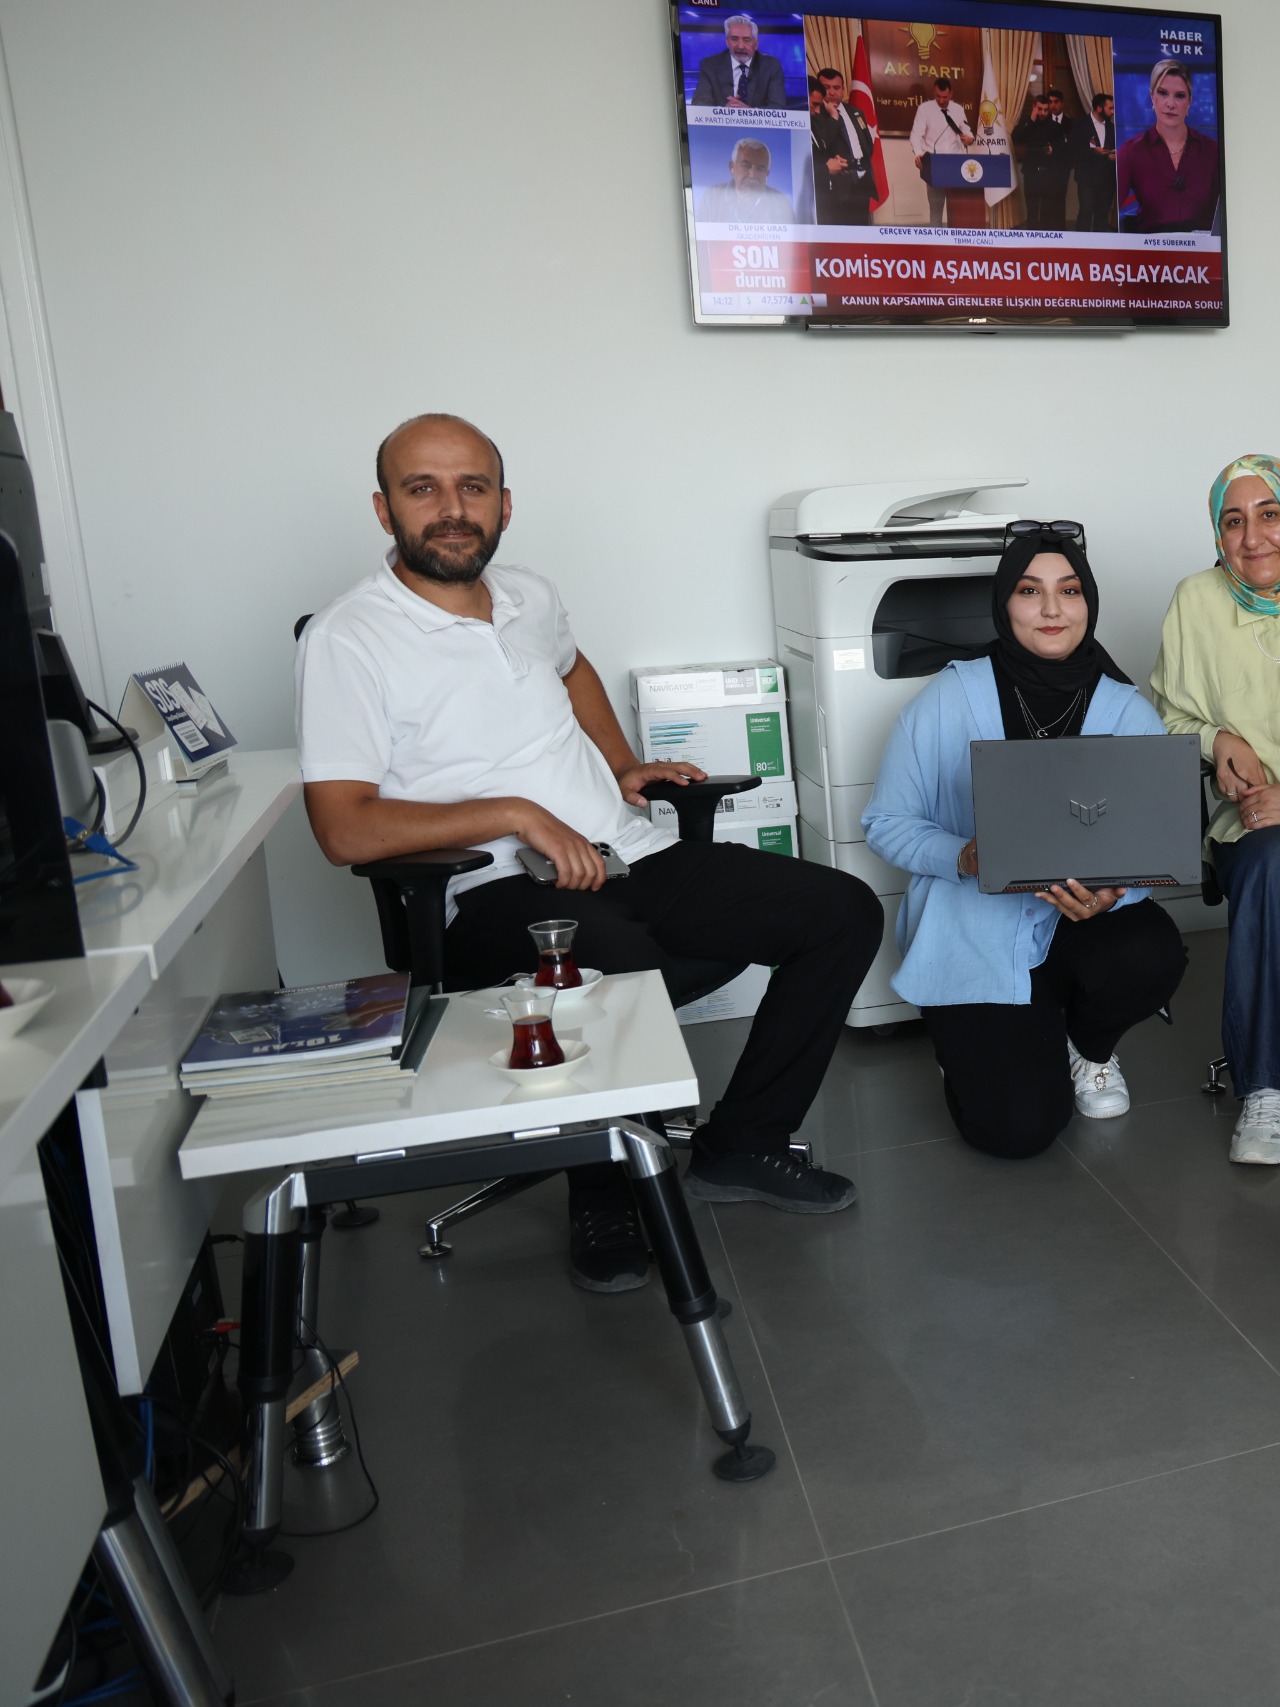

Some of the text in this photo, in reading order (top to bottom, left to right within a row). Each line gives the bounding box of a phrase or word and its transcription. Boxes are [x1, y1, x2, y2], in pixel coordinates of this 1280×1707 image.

[1160, 29, 1203, 42] HABER
[884, 61, 910, 76] AK
[712, 107, 787, 118] GALİP ENSARİOĞLU
[744, 224, 765, 232] UFUK
[879, 227, 1063, 239] ÇERÇEVE YASA İÇİN BİRAZDAN AÇIKLAMA YAPILACAK
[1143, 238, 1196, 247] AYŞE SÜBERKER
[732, 245, 779, 269] SON
[815, 254, 1210, 287] KOMİSYON AŞAMASI CUMA BAŞLAYACAK
[735, 271, 787, 288] durum
[841, 295, 880, 306] KANUN
[882, 295, 945, 306] KAPSAMINA
[947, 295, 1003, 307] GİRENLERE
[1006, 295, 1042, 308] İLİŞKİN
[1044, 296, 1126, 308] DEĞERLENDİRME
[1128, 297, 1192, 309] HALİHAZIRDA
[649, 683, 694, 693] NAVIGATOR
[144, 677, 181, 714] SDS
[756, 761, 767, 772] 80
